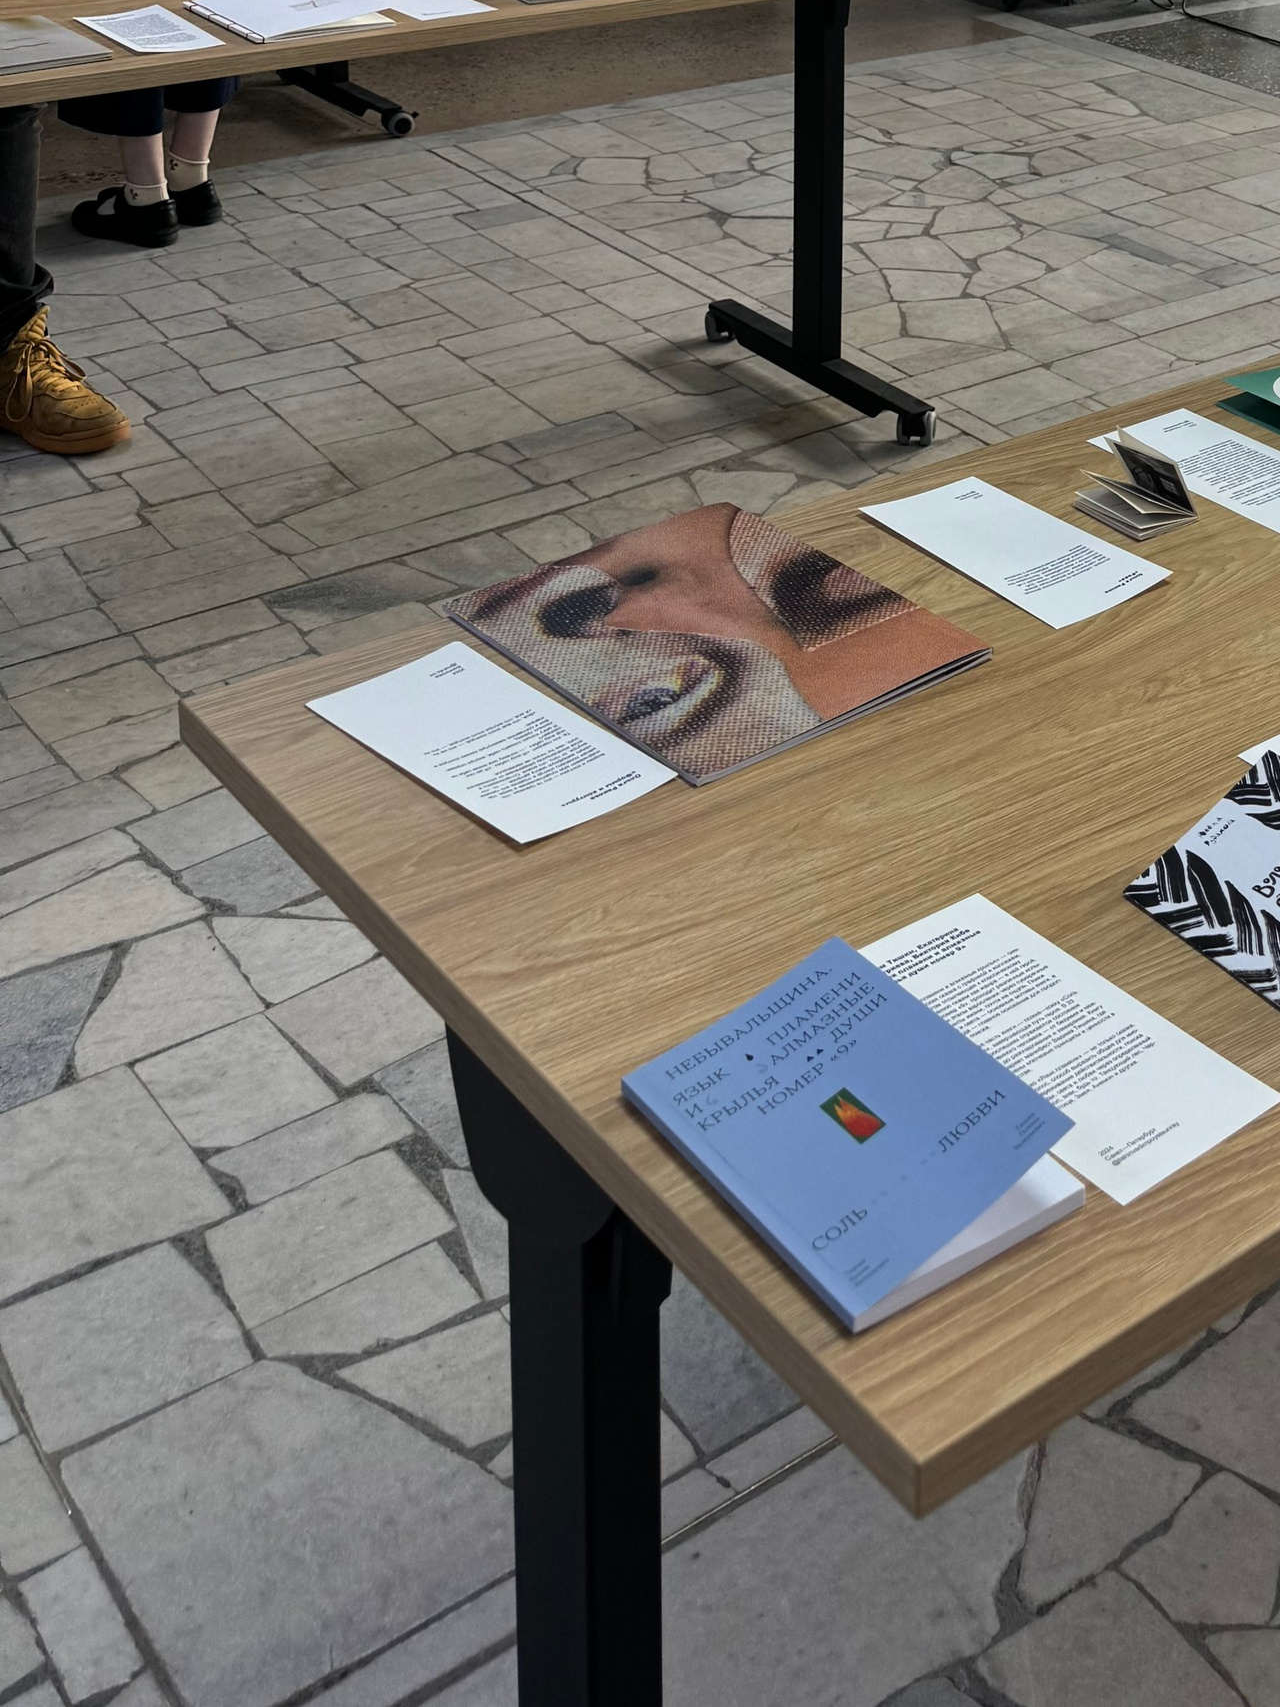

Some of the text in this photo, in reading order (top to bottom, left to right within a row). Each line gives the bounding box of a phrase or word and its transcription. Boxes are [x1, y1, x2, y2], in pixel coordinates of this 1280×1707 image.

[896, 954, 934, 974] пламени
[939, 929, 982, 952] алмазные
[911, 938, 951, 959] Виктория
[916, 927, 960, 950] Екатерина
[664, 964, 834, 1081] НЕБЫВАЛЬЩИНА.
[670, 971, 862, 1107] ЯЗЫК ПЛАМЕНИ
[683, 981, 876, 1119] И АЛМАЗНЫЕ
[696, 991, 889, 1133] КРЫЛЬЯ ДУШИ
[755, 1036, 861, 1115] НОМЕР «9»
[808, 1203, 870, 1254] СОЛЬ
[933, 1087, 1007, 1153] ЛЮБВИ
